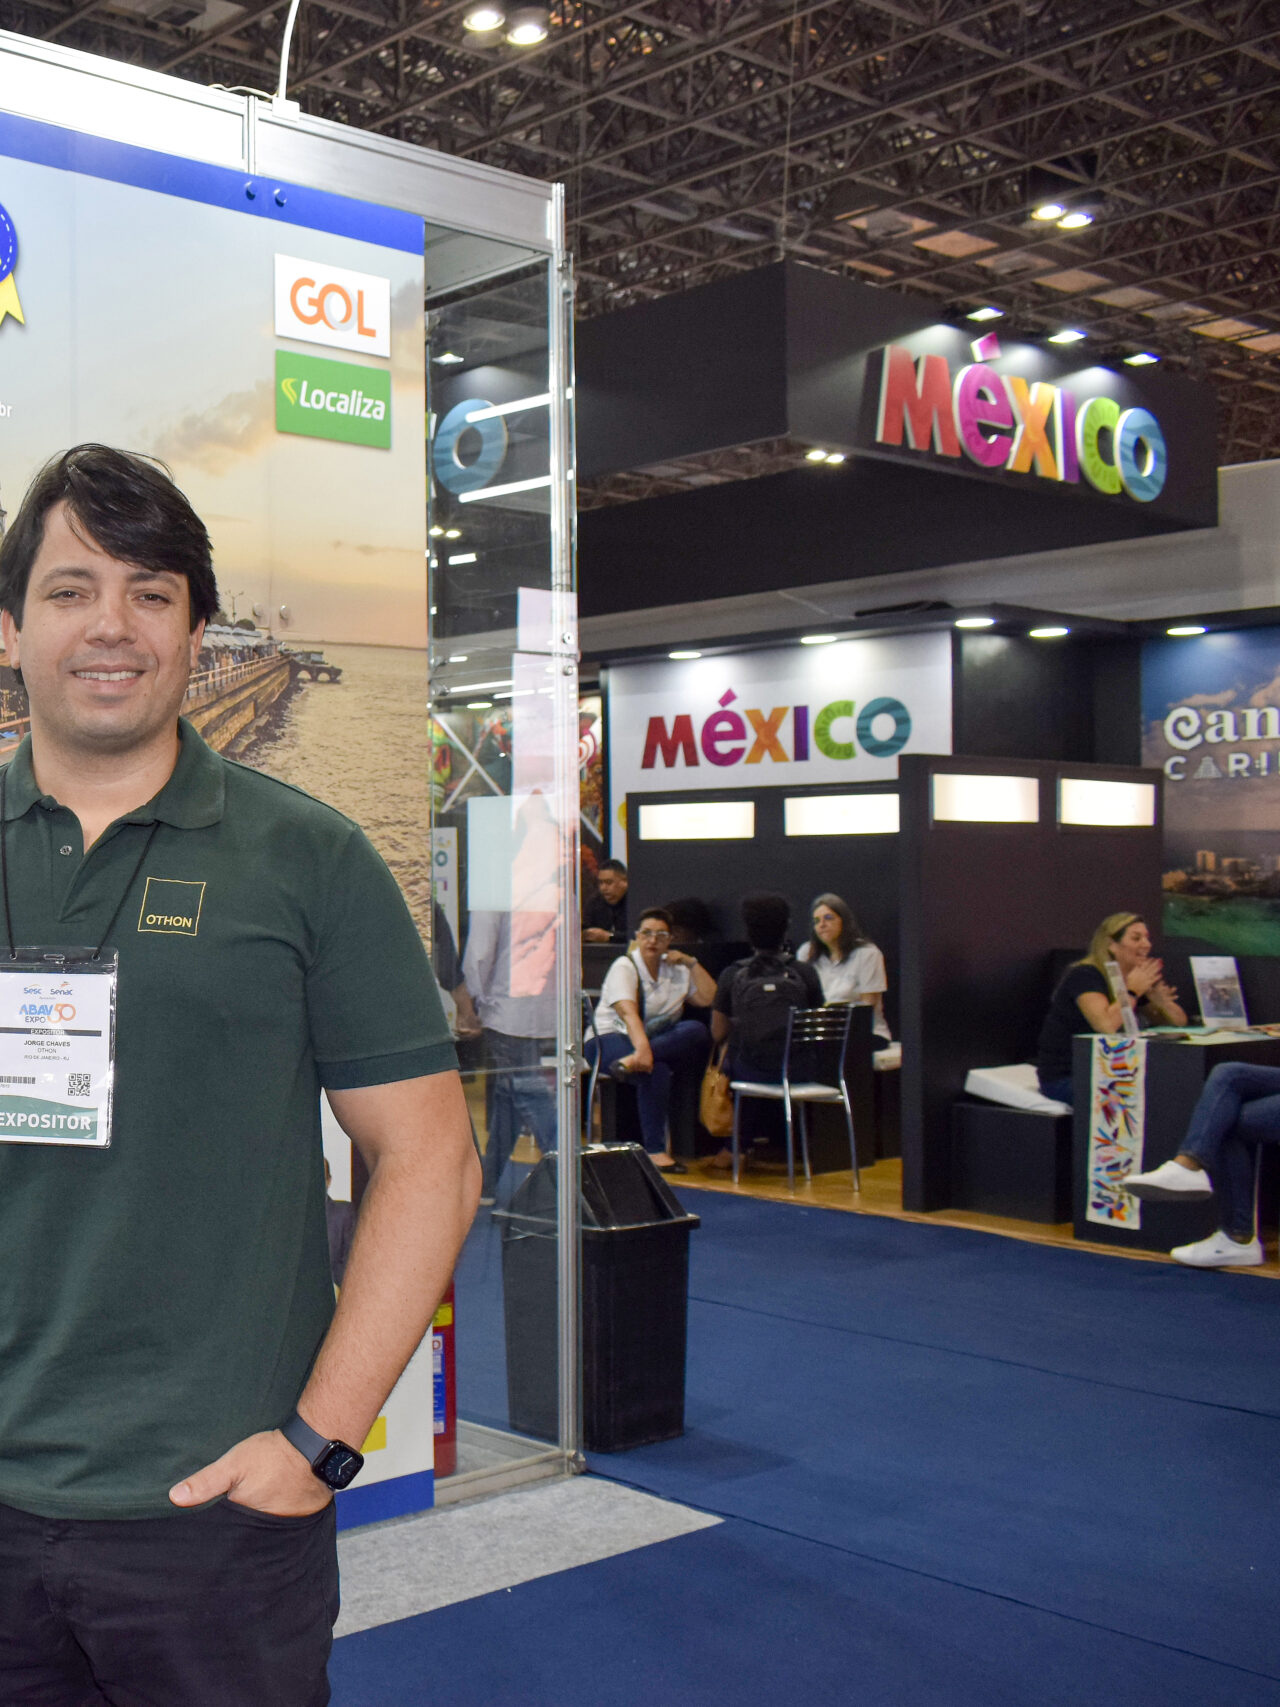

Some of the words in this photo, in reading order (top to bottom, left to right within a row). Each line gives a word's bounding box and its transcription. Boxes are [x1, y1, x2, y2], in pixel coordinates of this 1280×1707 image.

[290, 277, 377, 338] GOL
[300, 380, 385, 421] Localiza
[146, 914, 192, 928] OTHON
[19, 1004, 53, 1016] ABAV
